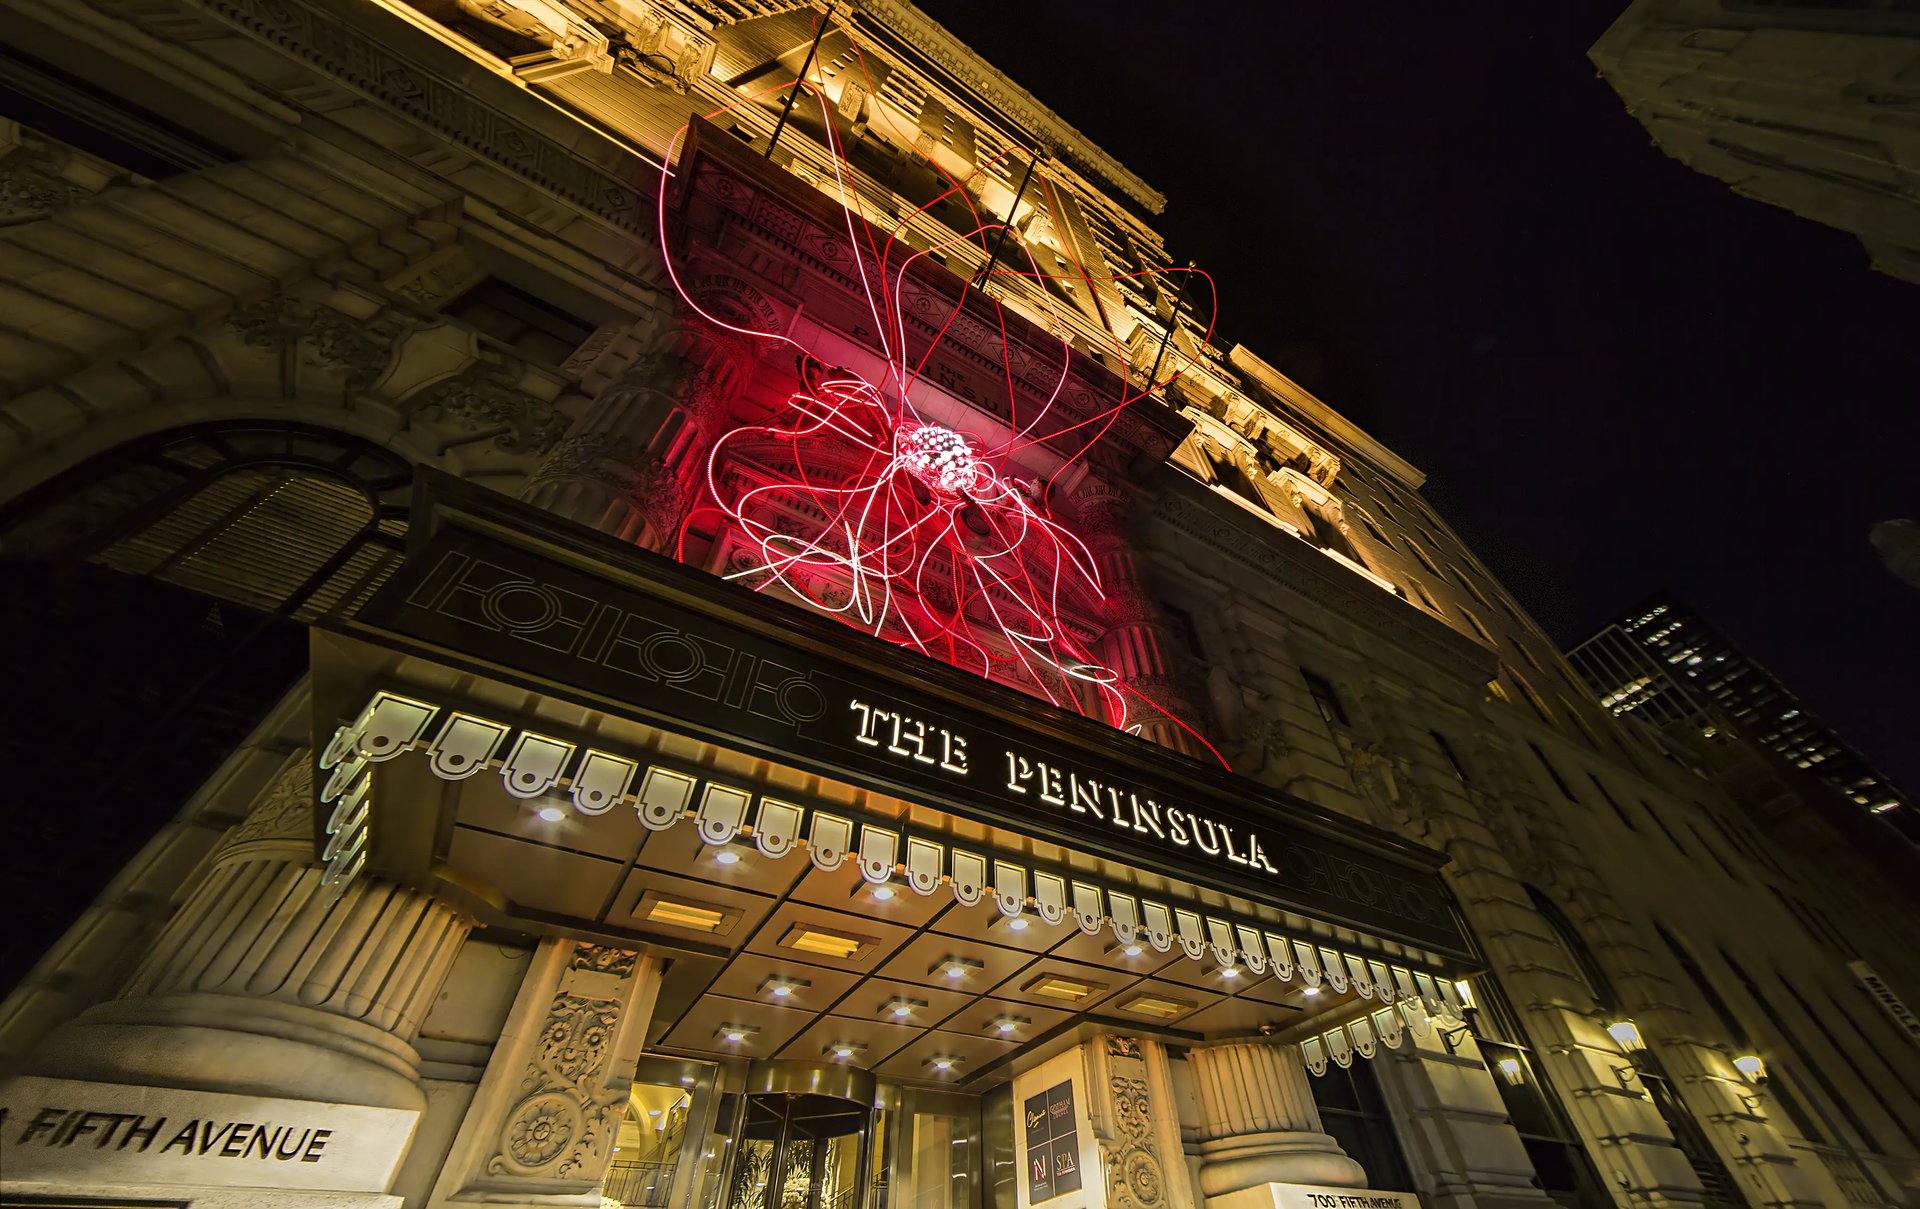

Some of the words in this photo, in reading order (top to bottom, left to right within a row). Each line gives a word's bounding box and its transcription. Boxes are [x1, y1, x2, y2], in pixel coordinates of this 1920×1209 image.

[850, 699, 969, 775] THE
[1005, 751, 1278, 874] PENINSULA
[16, 1107, 167, 1153] FIFTH
[159, 1119, 333, 1162] AVENUE
[1033, 1155, 1046, 1183] N
[1056, 1151, 1074, 1170] SPA
[1306, 1194, 1336, 1208] 700
[1338, 1195, 1371, 1209] FIFTH
